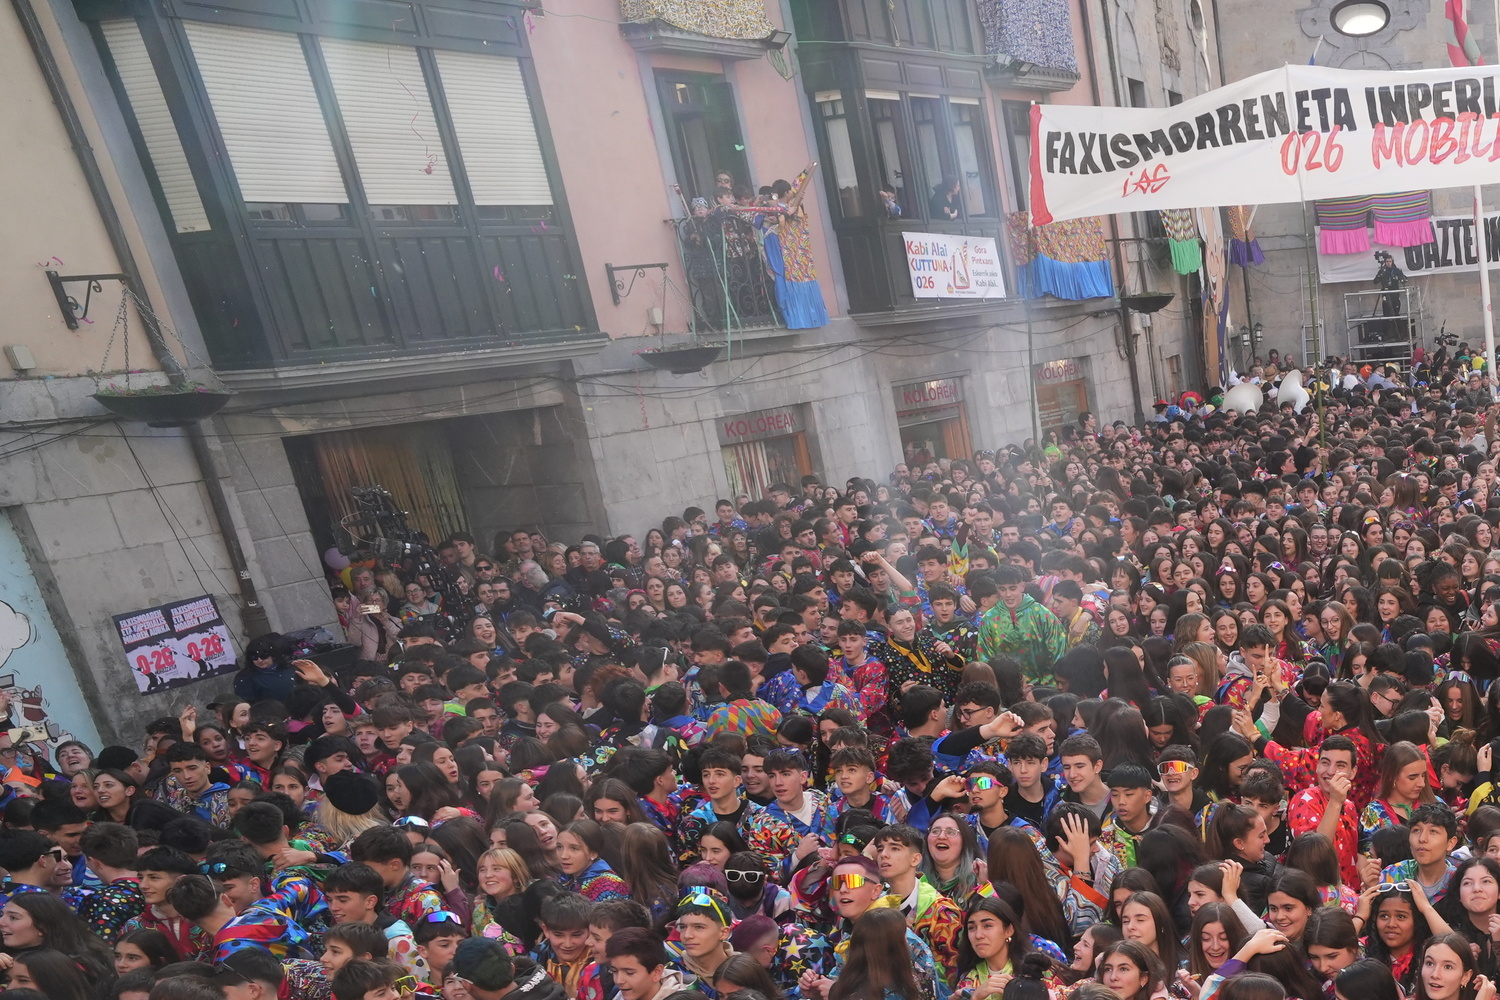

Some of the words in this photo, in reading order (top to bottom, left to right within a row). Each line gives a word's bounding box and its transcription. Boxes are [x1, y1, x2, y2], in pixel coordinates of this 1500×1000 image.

[1046, 92, 1291, 175] FAXISMOAREN
[1295, 87, 1357, 133] ETA
[906, 240, 929, 255] Kabi
[931, 241, 948, 257] Alai
[974, 245, 988, 254] Gora
[909, 257, 949, 272] KUTTUNA
[975, 279, 987, 287] Kabi
[903, 384, 959, 404] KOLOREAK
[723, 412, 797, 438] KOLOREAK
[170, 597, 211, 616] FAXISMOAREN
[119, 609, 164, 629] FAXISMOAREN
[173, 614, 185, 625] ETA
[174, 617, 199, 632] MOAREN
[199, 611, 219, 624] AURKA
[121, 626, 132, 637] ETA
[123, 630, 150, 645] MOAREN
[150, 623, 170, 636] AURKA
